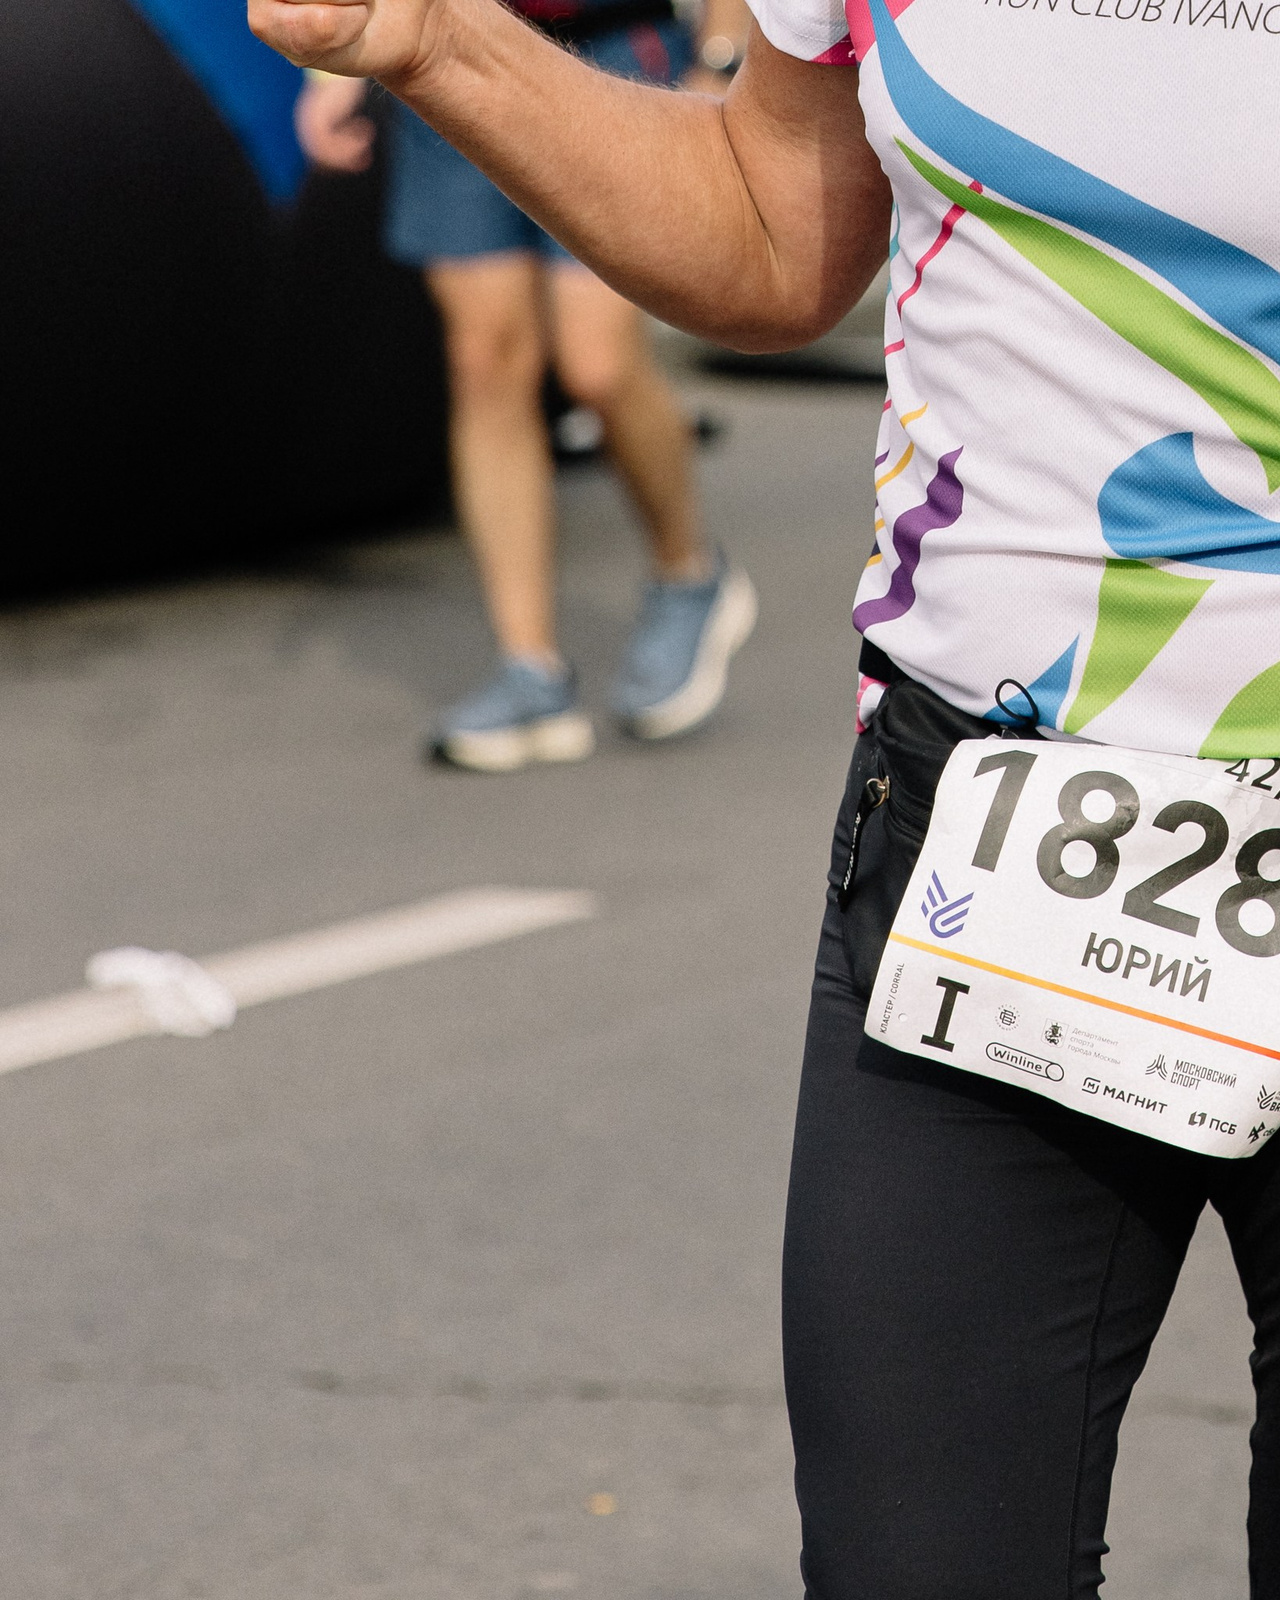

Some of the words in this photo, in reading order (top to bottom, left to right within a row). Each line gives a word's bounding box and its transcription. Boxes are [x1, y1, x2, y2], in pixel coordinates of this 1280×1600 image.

[1081, 931, 1212, 1003] ЮРИЙ
[880, 1000, 895, 1034] КЛАСТЕР
[890, 963, 905, 994] CORRAL
[993, 1046, 1043, 1072] Winline
[1174, 1059, 1237, 1088] МОСКОВСКИЙ
[1170, 1072, 1201, 1090] СПОРТ
[1103, 1085, 1168, 1114] МАГНИТ
[1209, 1117, 1238, 1135] ПСБ
